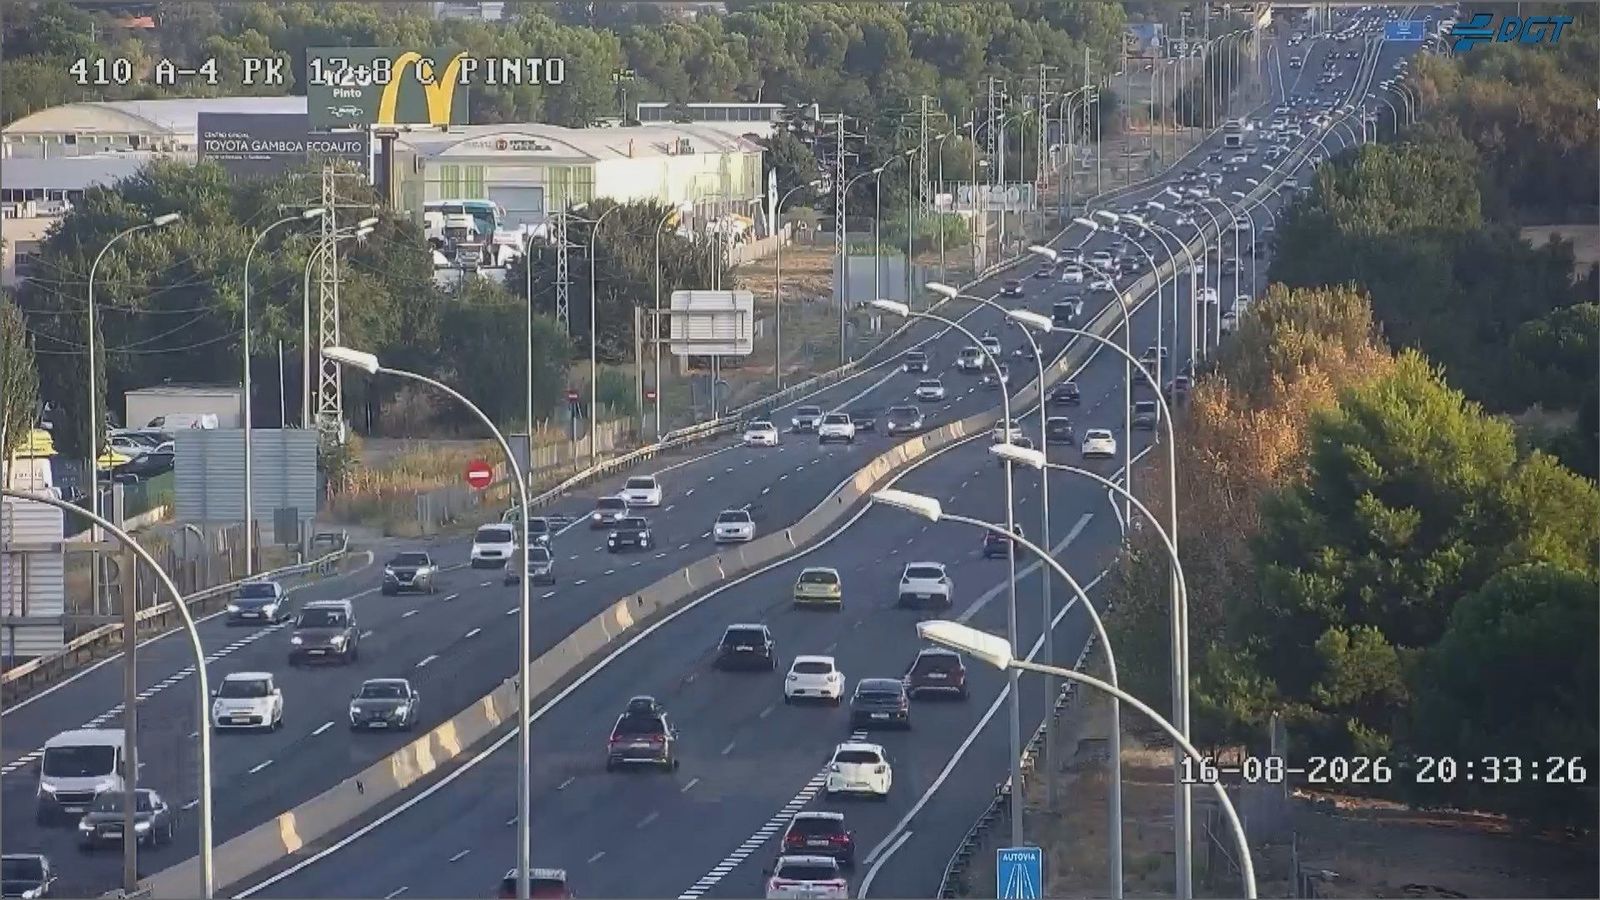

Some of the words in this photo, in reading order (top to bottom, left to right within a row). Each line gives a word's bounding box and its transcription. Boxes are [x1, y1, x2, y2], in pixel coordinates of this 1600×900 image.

[333, 88, 362, 98] Pinto
[204, 140, 249, 151] TOYOTA
[251, 141, 304, 152] GAMBOA
[306, 141, 362, 152] ECOAUTO
[1002, 853, 1036, 861] AUTOVIA
